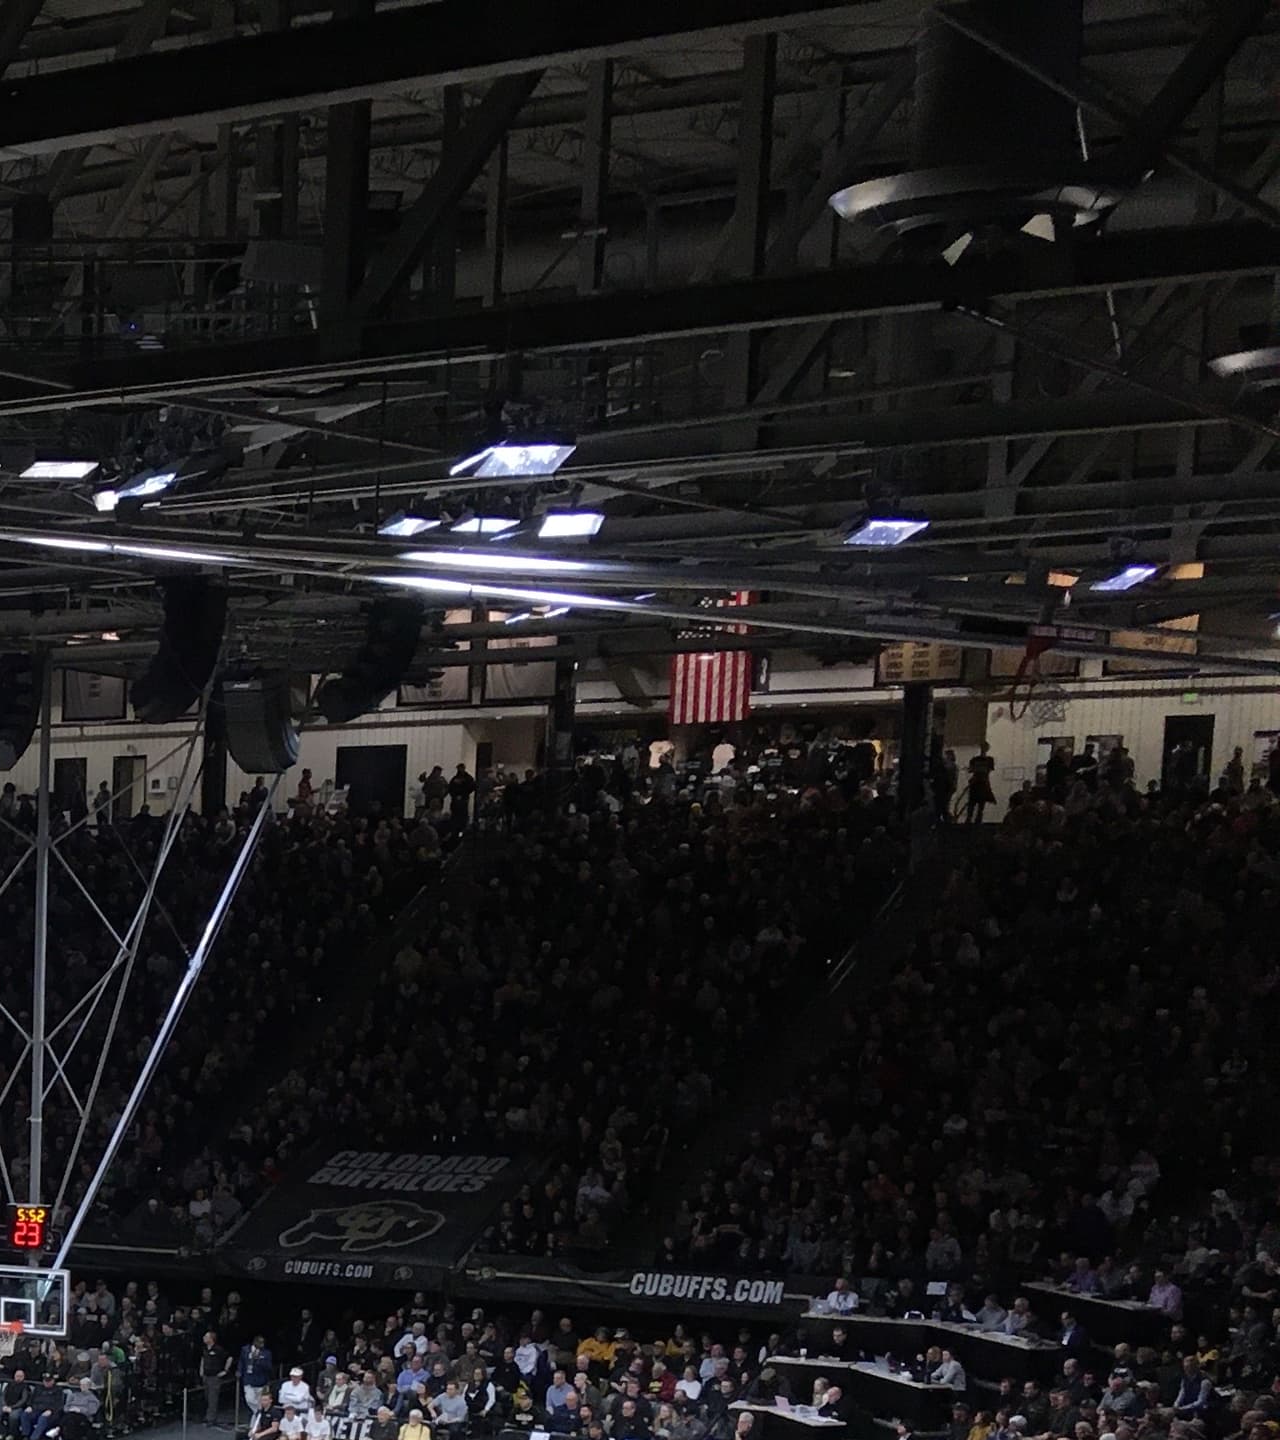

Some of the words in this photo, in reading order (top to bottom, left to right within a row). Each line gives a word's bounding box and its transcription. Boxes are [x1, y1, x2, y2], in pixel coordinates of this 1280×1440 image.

[325, 1150, 512, 1175] COLORADO
[305, 1167, 493, 1193] BUFFALOES
[17, 1207, 46, 1224] 5:52
[13, 1222, 41, 1247] 23
[284, 1259, 375, 1280] CUBUFFS.COM
[629, 1272, 785, 1305] CUBUFFS.COM
